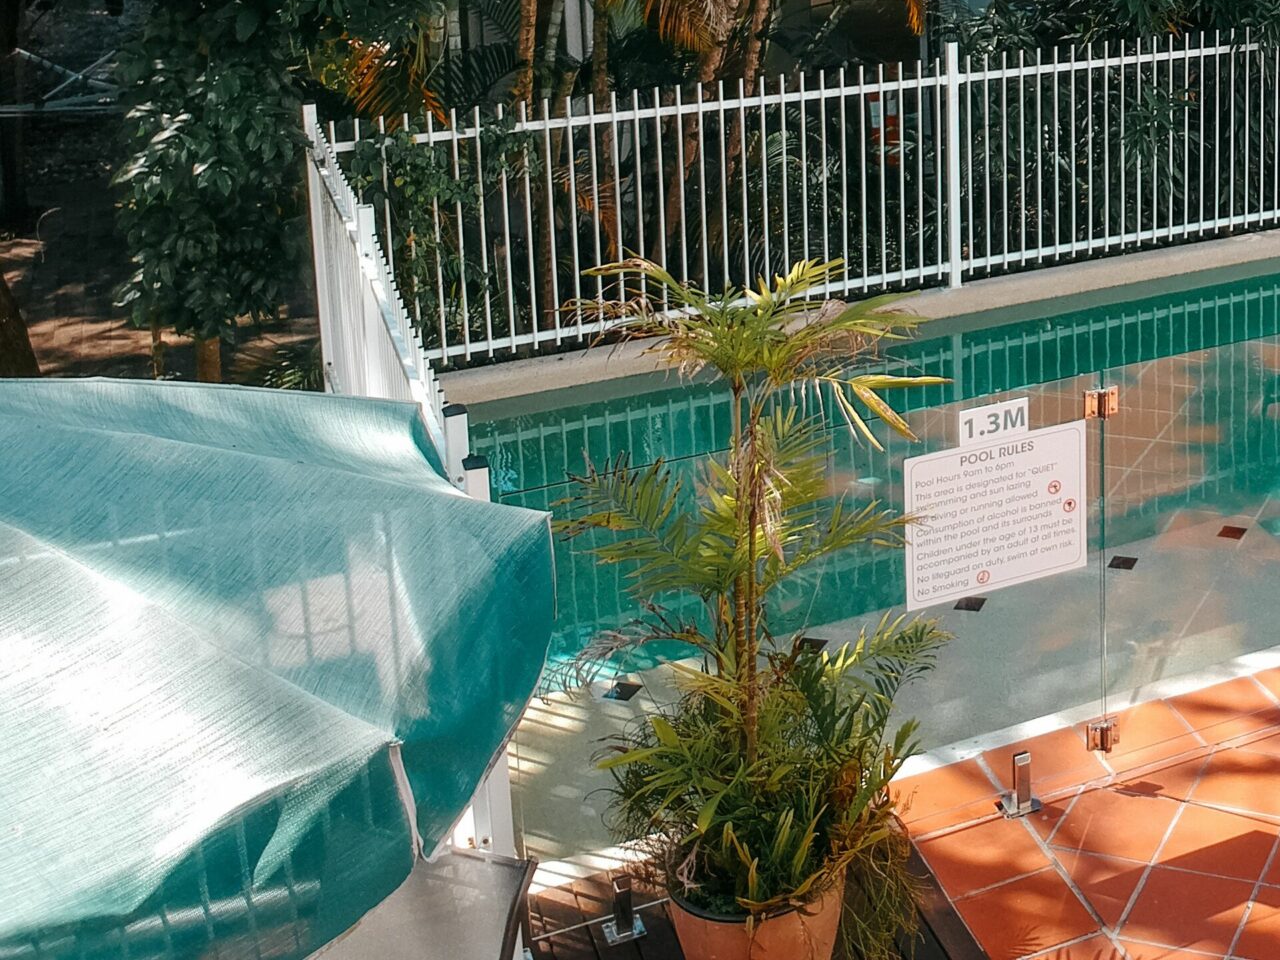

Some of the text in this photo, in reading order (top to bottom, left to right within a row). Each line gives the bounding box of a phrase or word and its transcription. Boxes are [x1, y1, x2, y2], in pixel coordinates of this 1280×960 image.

[963, 406, 1026, 439] 1.3M
[960, 441, 1034, 466] POOL RULES
[915, 479, 934, 489] Pool
[936, 473, 961, 484] Hours
[963, 468, 982, 478] 9am
[995, 461, 1015, 471] 6pm
[915, 492, 932, 502] This
[934, 488, 955, 497] area
[956, 485, 963, 494] is
[965, 473, 1014, 491] designated
[1016, 470, 1027, 479] for
[969, 489, 988, 500] and
[989, 486, 1004, 495] sun
[1006, 480, 1031, 491] lazing
[916, 497, 1062, 538] Consumption of alcohol is banned
[930, 509, 958, 521] diving
[960, 506, 969, 515] or
[971, 499, 1004, 512] running
[1005, 490, 1038, 504] allowed
[916, 510, 1053, 548] within the pool and its surrounds
[916, 517, 1073, 561] Children under the age of 13 must be
[916, 550, 979, 571] accompanied
[981, 547, 991, 557] by
[993, 544, 1005, 553] an
[1006, 537, 1029, 549] adult
[1030, 534, 1040, 543] at
[1041, 531, 1052, 541] all
[917, 575, 930, 584] No
[931, 564, 970, 579] lifeguard
[971, 561, 984, 570] on
[1006, 551, 1028, 562] swim
[1029, 547, 1038, 556] at
[1040, 543, 1058, 553] own
[917, 578, 969, 597] No Smoking
